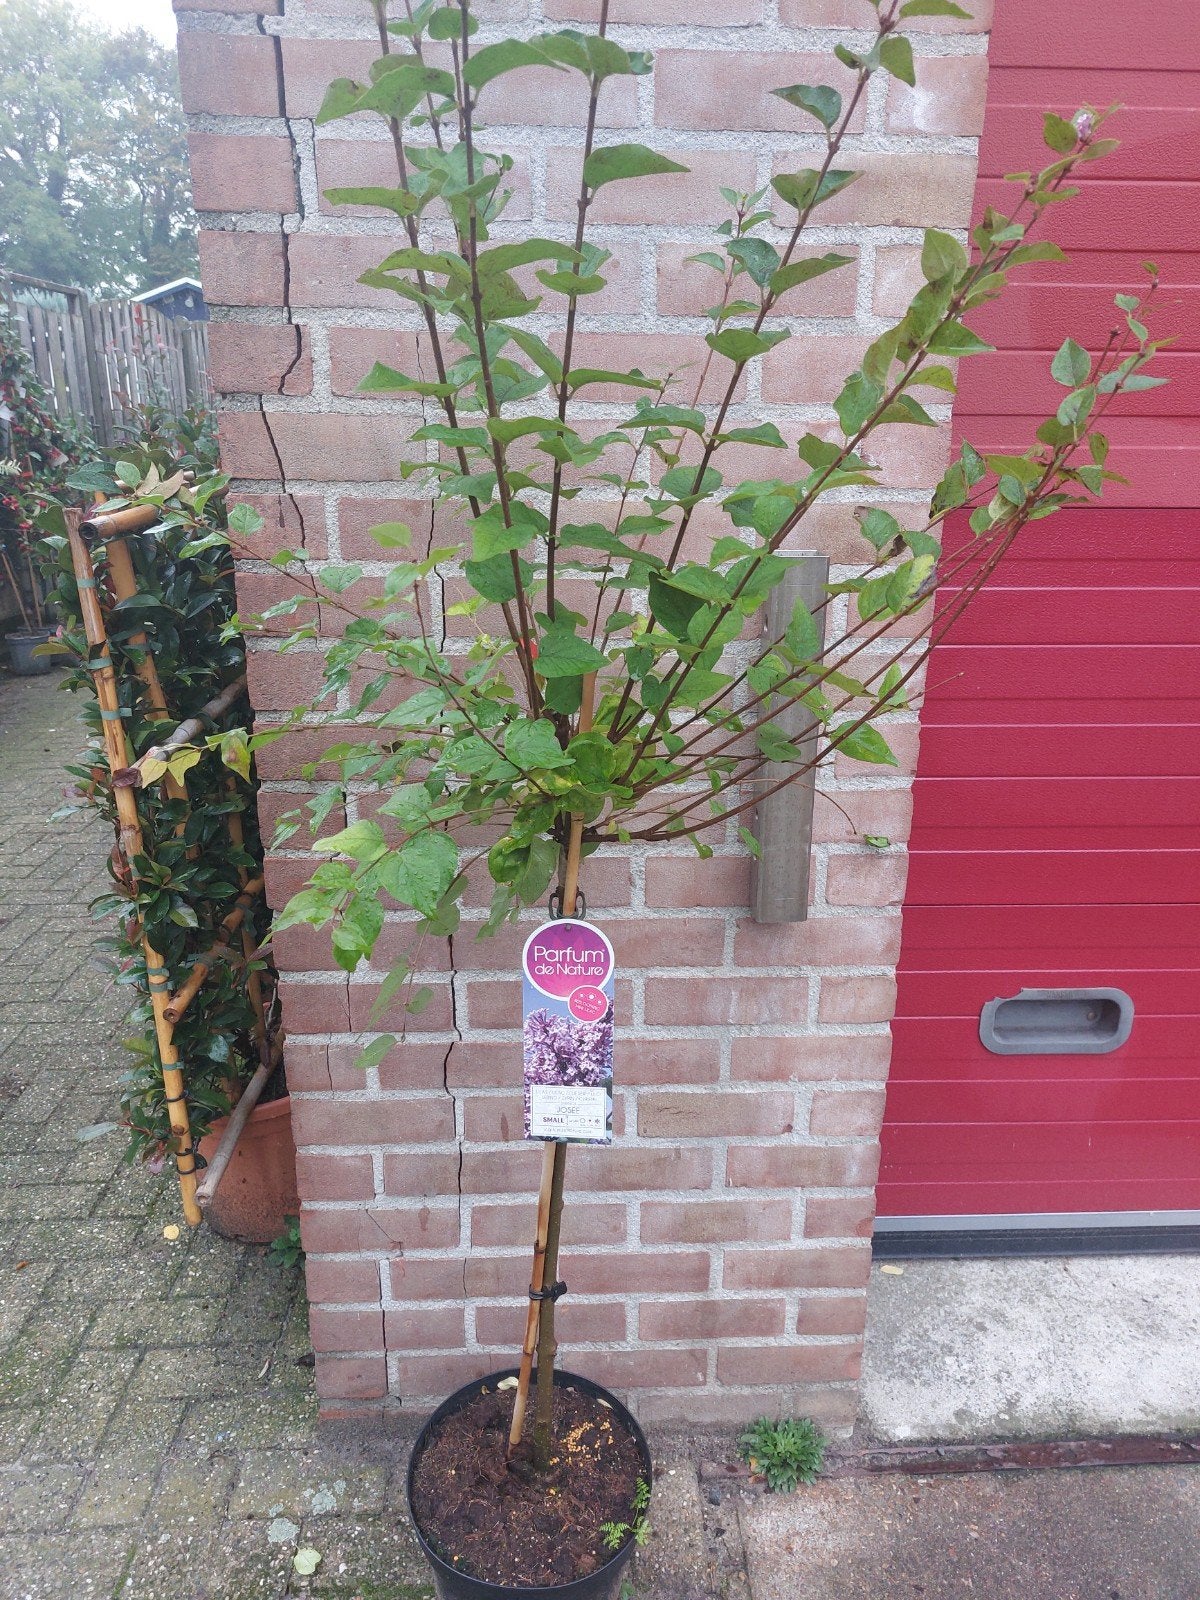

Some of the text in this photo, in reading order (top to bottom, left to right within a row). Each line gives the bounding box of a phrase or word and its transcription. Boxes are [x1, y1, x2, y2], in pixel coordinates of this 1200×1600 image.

[534, 946, 604, 962] Parfum
[534, 963, 604, 976] de Nature
[542, 1116, 565, 1124] SMALL
